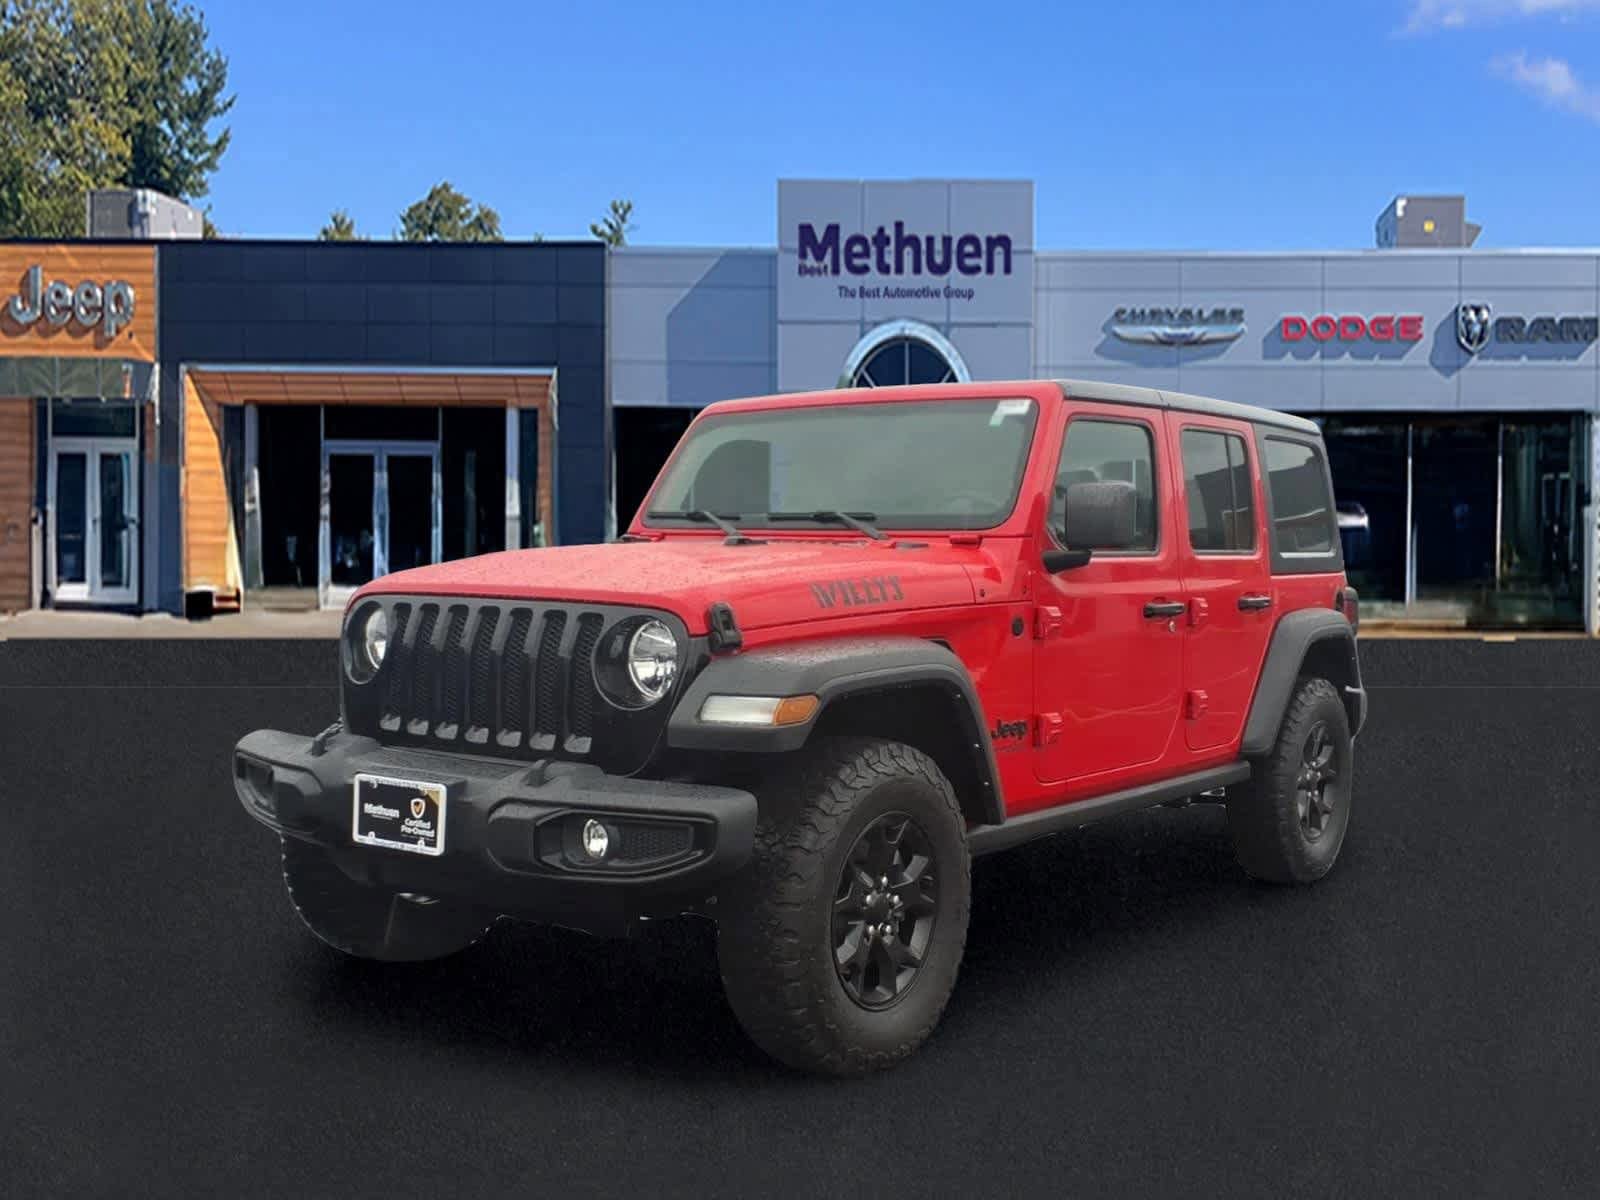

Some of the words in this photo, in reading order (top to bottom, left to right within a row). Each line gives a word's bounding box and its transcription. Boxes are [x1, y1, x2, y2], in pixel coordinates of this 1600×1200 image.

[798, 221, 1012, 276] Methuen
[9, 265, 135, 337] Jeep
[838, 286, 857, 298] The
[859, 286, 880, 298] Best
[883, 286, 941, 299] Automotive
[943, 286, 975, 301] Group
[1115, 307, 1245, 323] CHRYSLER
[1282, 315, 1424, 342] DODGE
[1495, 316, 1599, 343] RAM
[811, 575, 905, 608] WILLYS
[990, 719, 1028, 740] Jeep
[364, 802, 400, 818] Methuen
